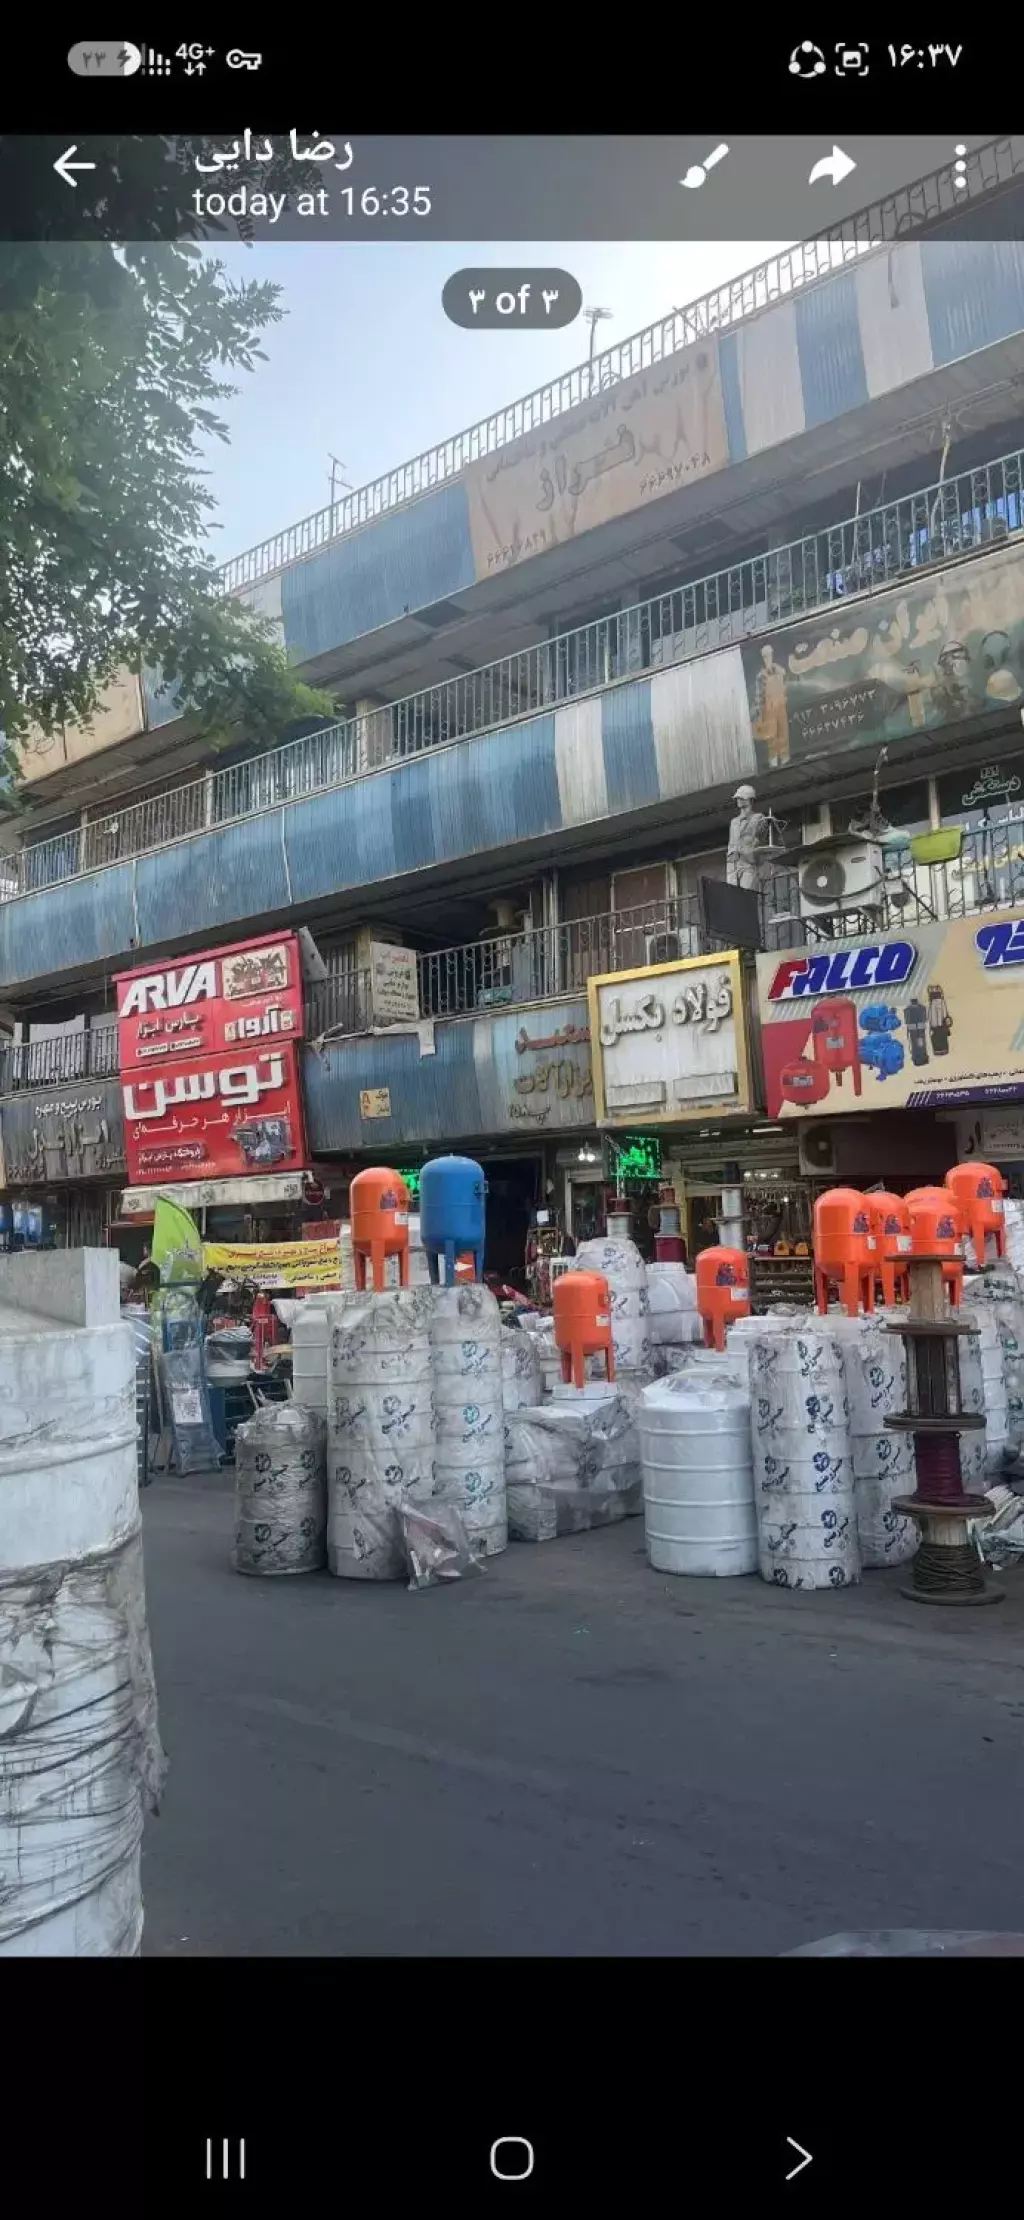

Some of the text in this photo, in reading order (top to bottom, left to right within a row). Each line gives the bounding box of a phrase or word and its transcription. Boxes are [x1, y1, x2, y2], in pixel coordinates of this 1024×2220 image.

[119, 961, 217, 1018] ARVA
[768, 941, 917, 1002] FALCO
[165, 1011, 200, 1037] پارس
[600, 975, 733, 1047] فولاد بکسل
[123, 1052, 286, 1121] توسن
[233, 1101, 292, 1125] ابزار
[203, 1113, 230, 1130] هر
